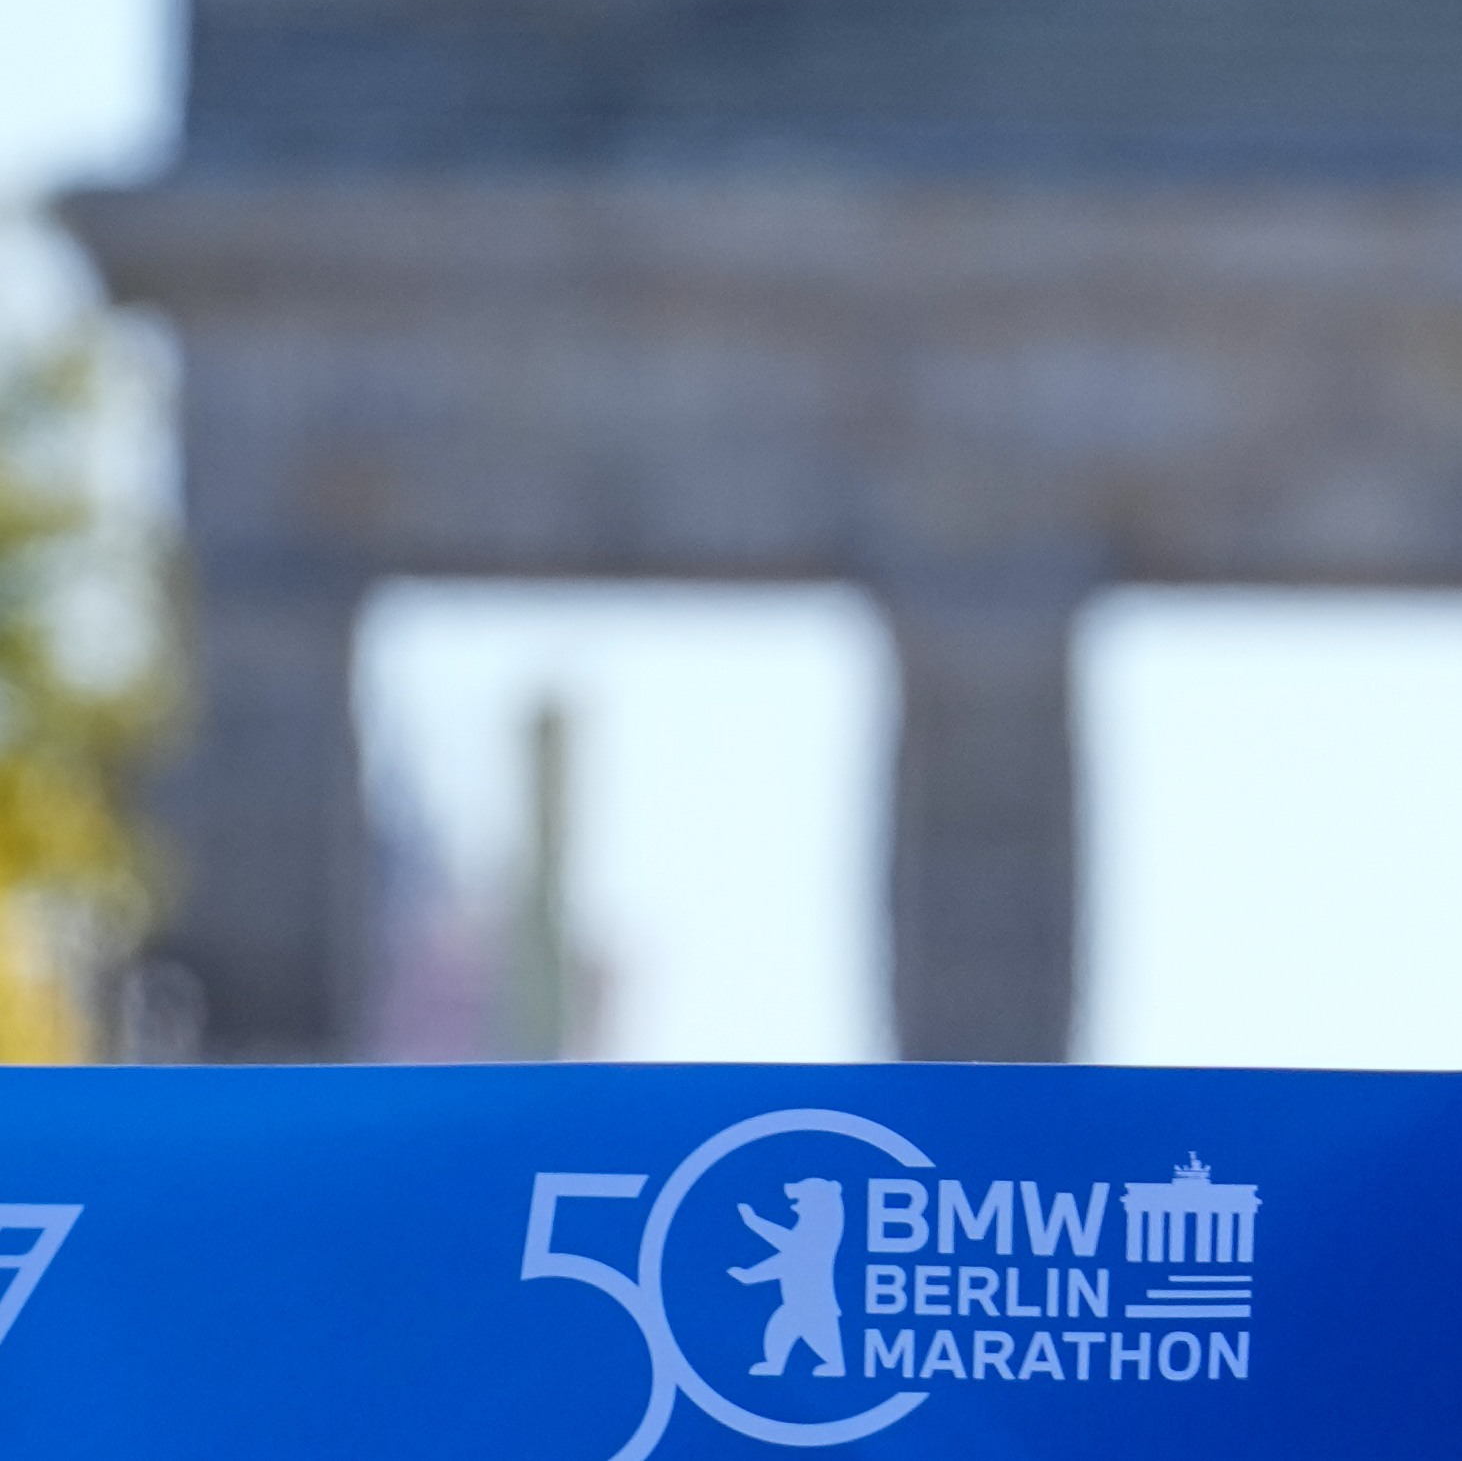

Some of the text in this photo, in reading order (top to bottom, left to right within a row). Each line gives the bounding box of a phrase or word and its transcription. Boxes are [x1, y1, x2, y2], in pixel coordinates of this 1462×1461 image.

[866, 1177, 1110, 1257] BMW
[865, 1264, 1110, 1318] BERLIN
[863, 1328, 1251, 1382] MARATHON
